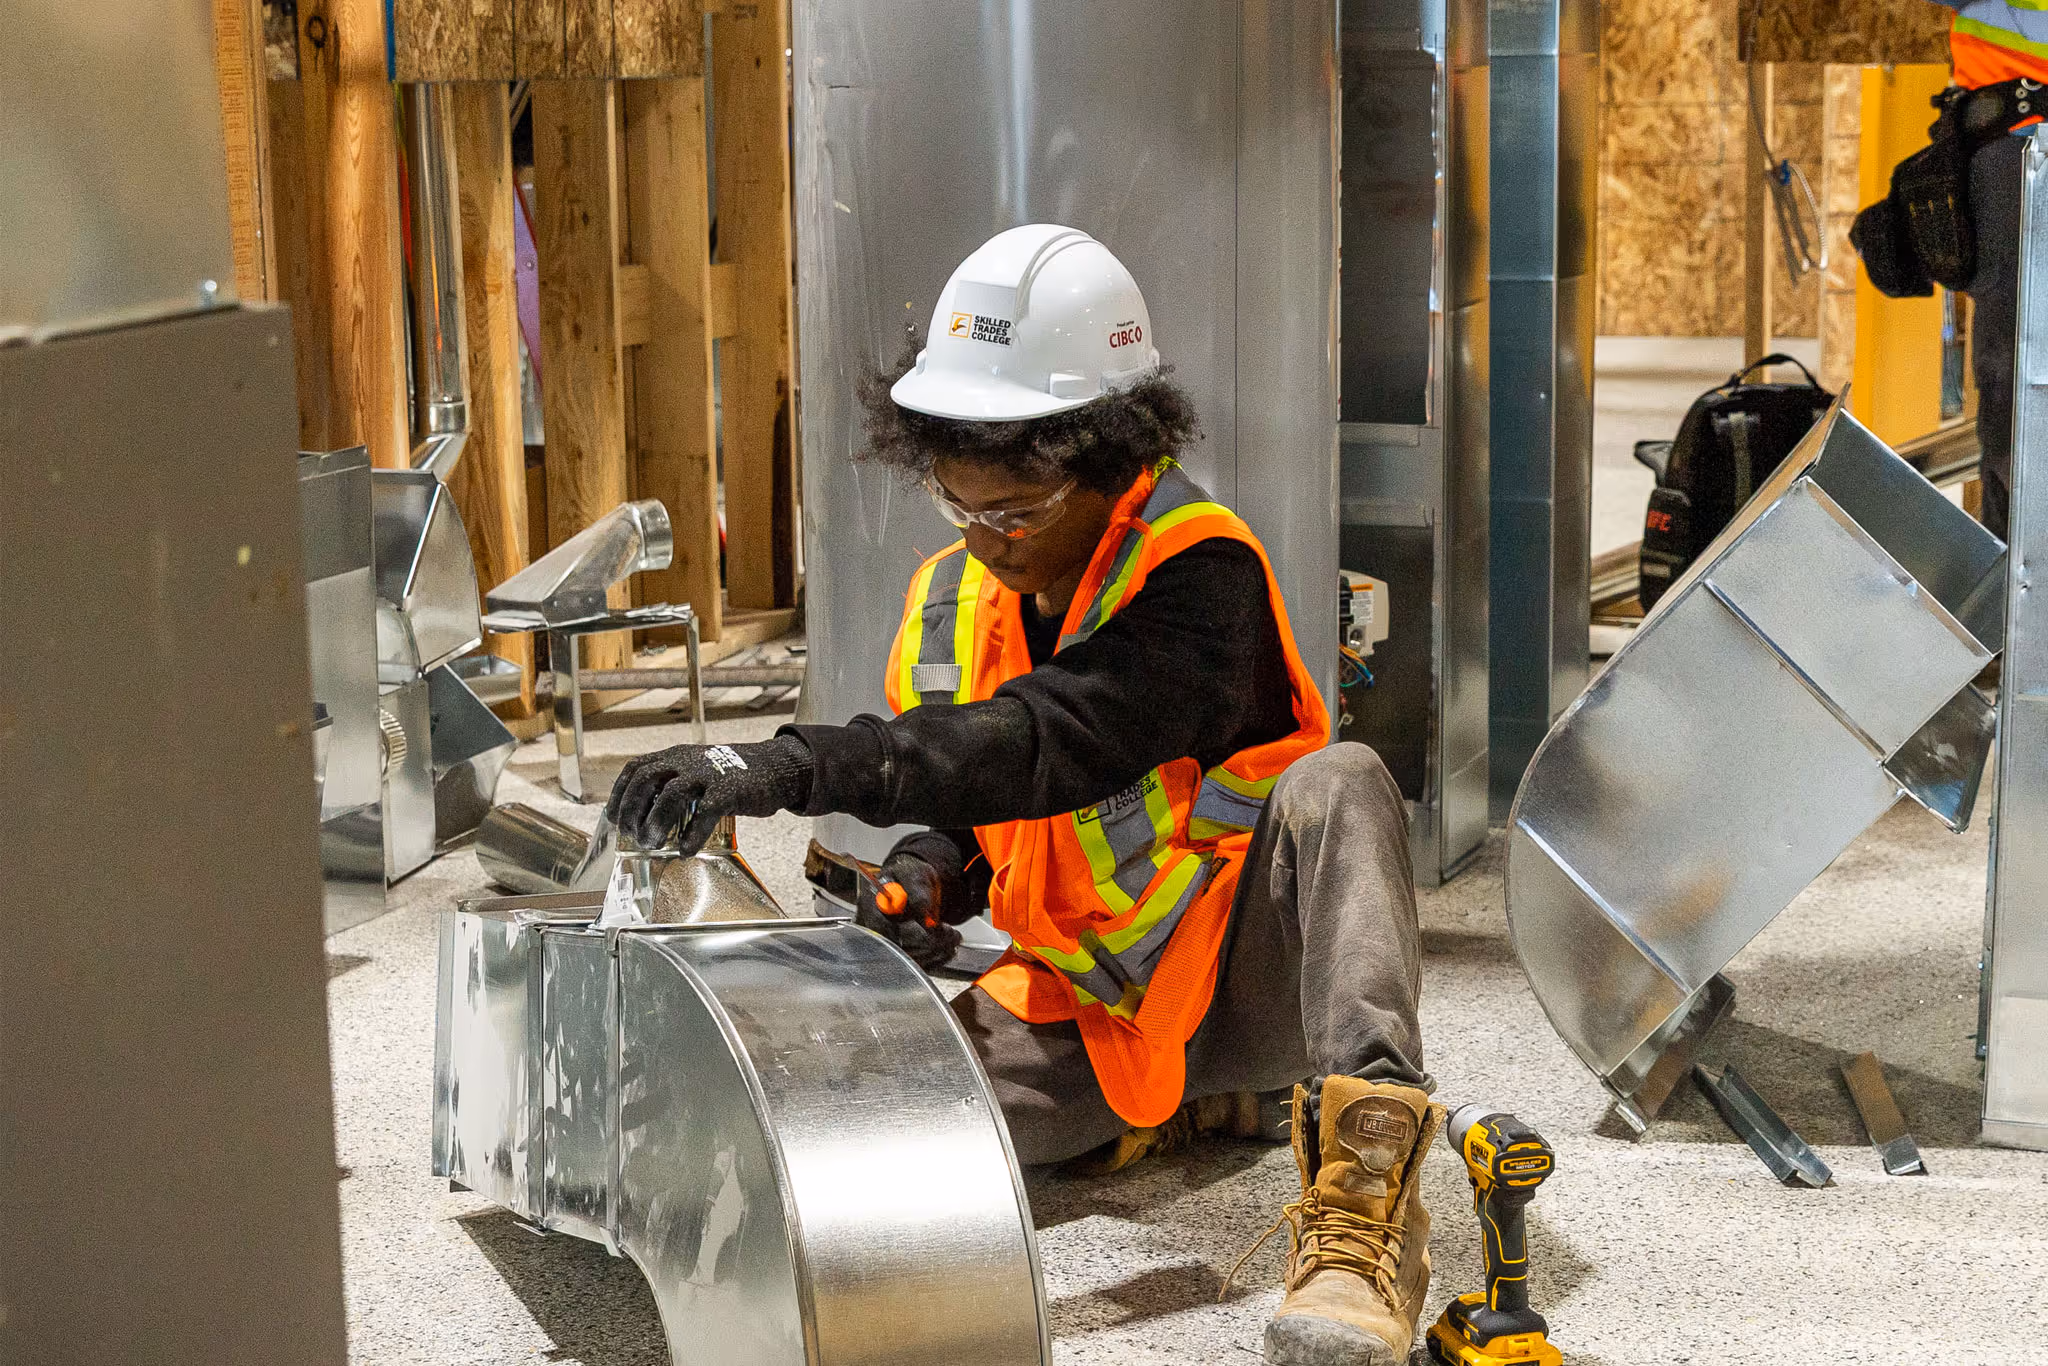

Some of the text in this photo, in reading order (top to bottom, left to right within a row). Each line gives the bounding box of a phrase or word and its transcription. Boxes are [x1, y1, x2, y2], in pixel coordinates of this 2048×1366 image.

[973, 323, 1008, 337] TRADES
[974, 315, 1011, 329] SKILLED
[971, 331, 1012, 346] COLLEGE
[1109, 325, 1143, 348] CIBCO
[1114, 776, 1151, 802] TRADES
[1115, 780, 1159, 811] COLLEGE
